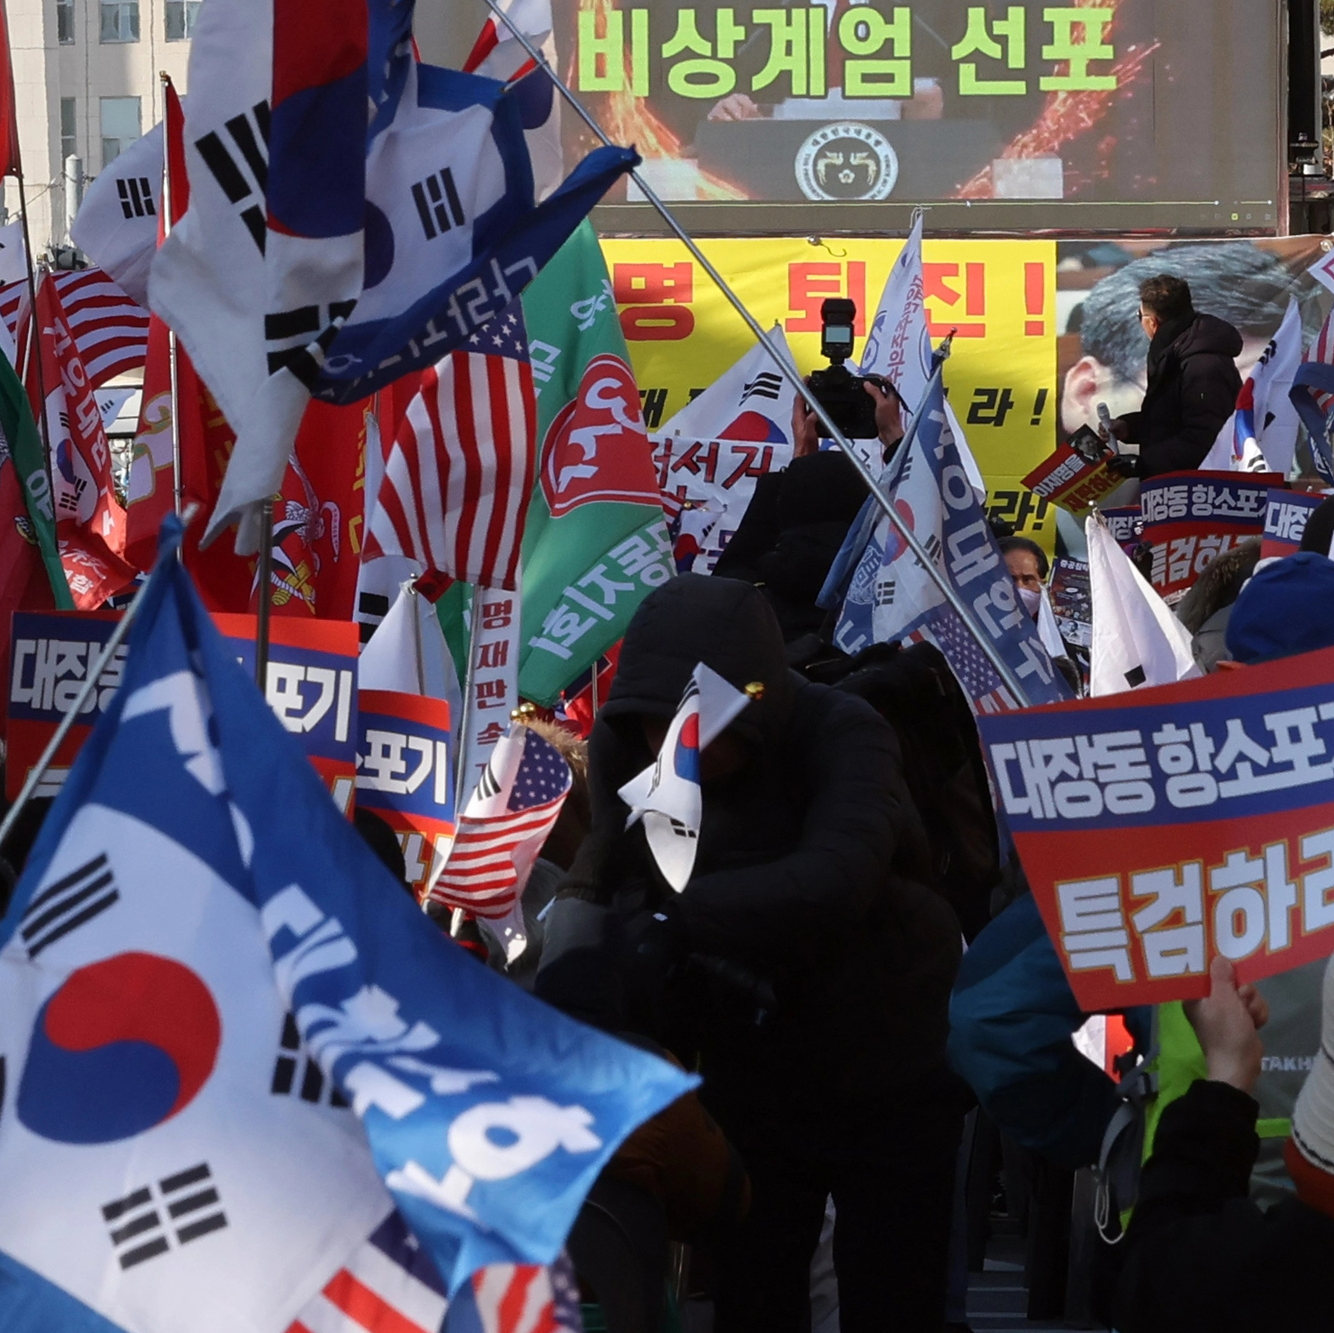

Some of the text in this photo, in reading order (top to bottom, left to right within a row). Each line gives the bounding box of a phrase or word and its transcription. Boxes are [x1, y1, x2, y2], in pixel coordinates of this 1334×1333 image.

[576, 6, 1117, 99] 비상계엄 선포
[1141, 485, 1188, 521] 대장동
[1265, 501, 1315, 541] 대장
[1151, 535, 1263, 586] 특검하
[989, 727, 1155, 819] 대장동
